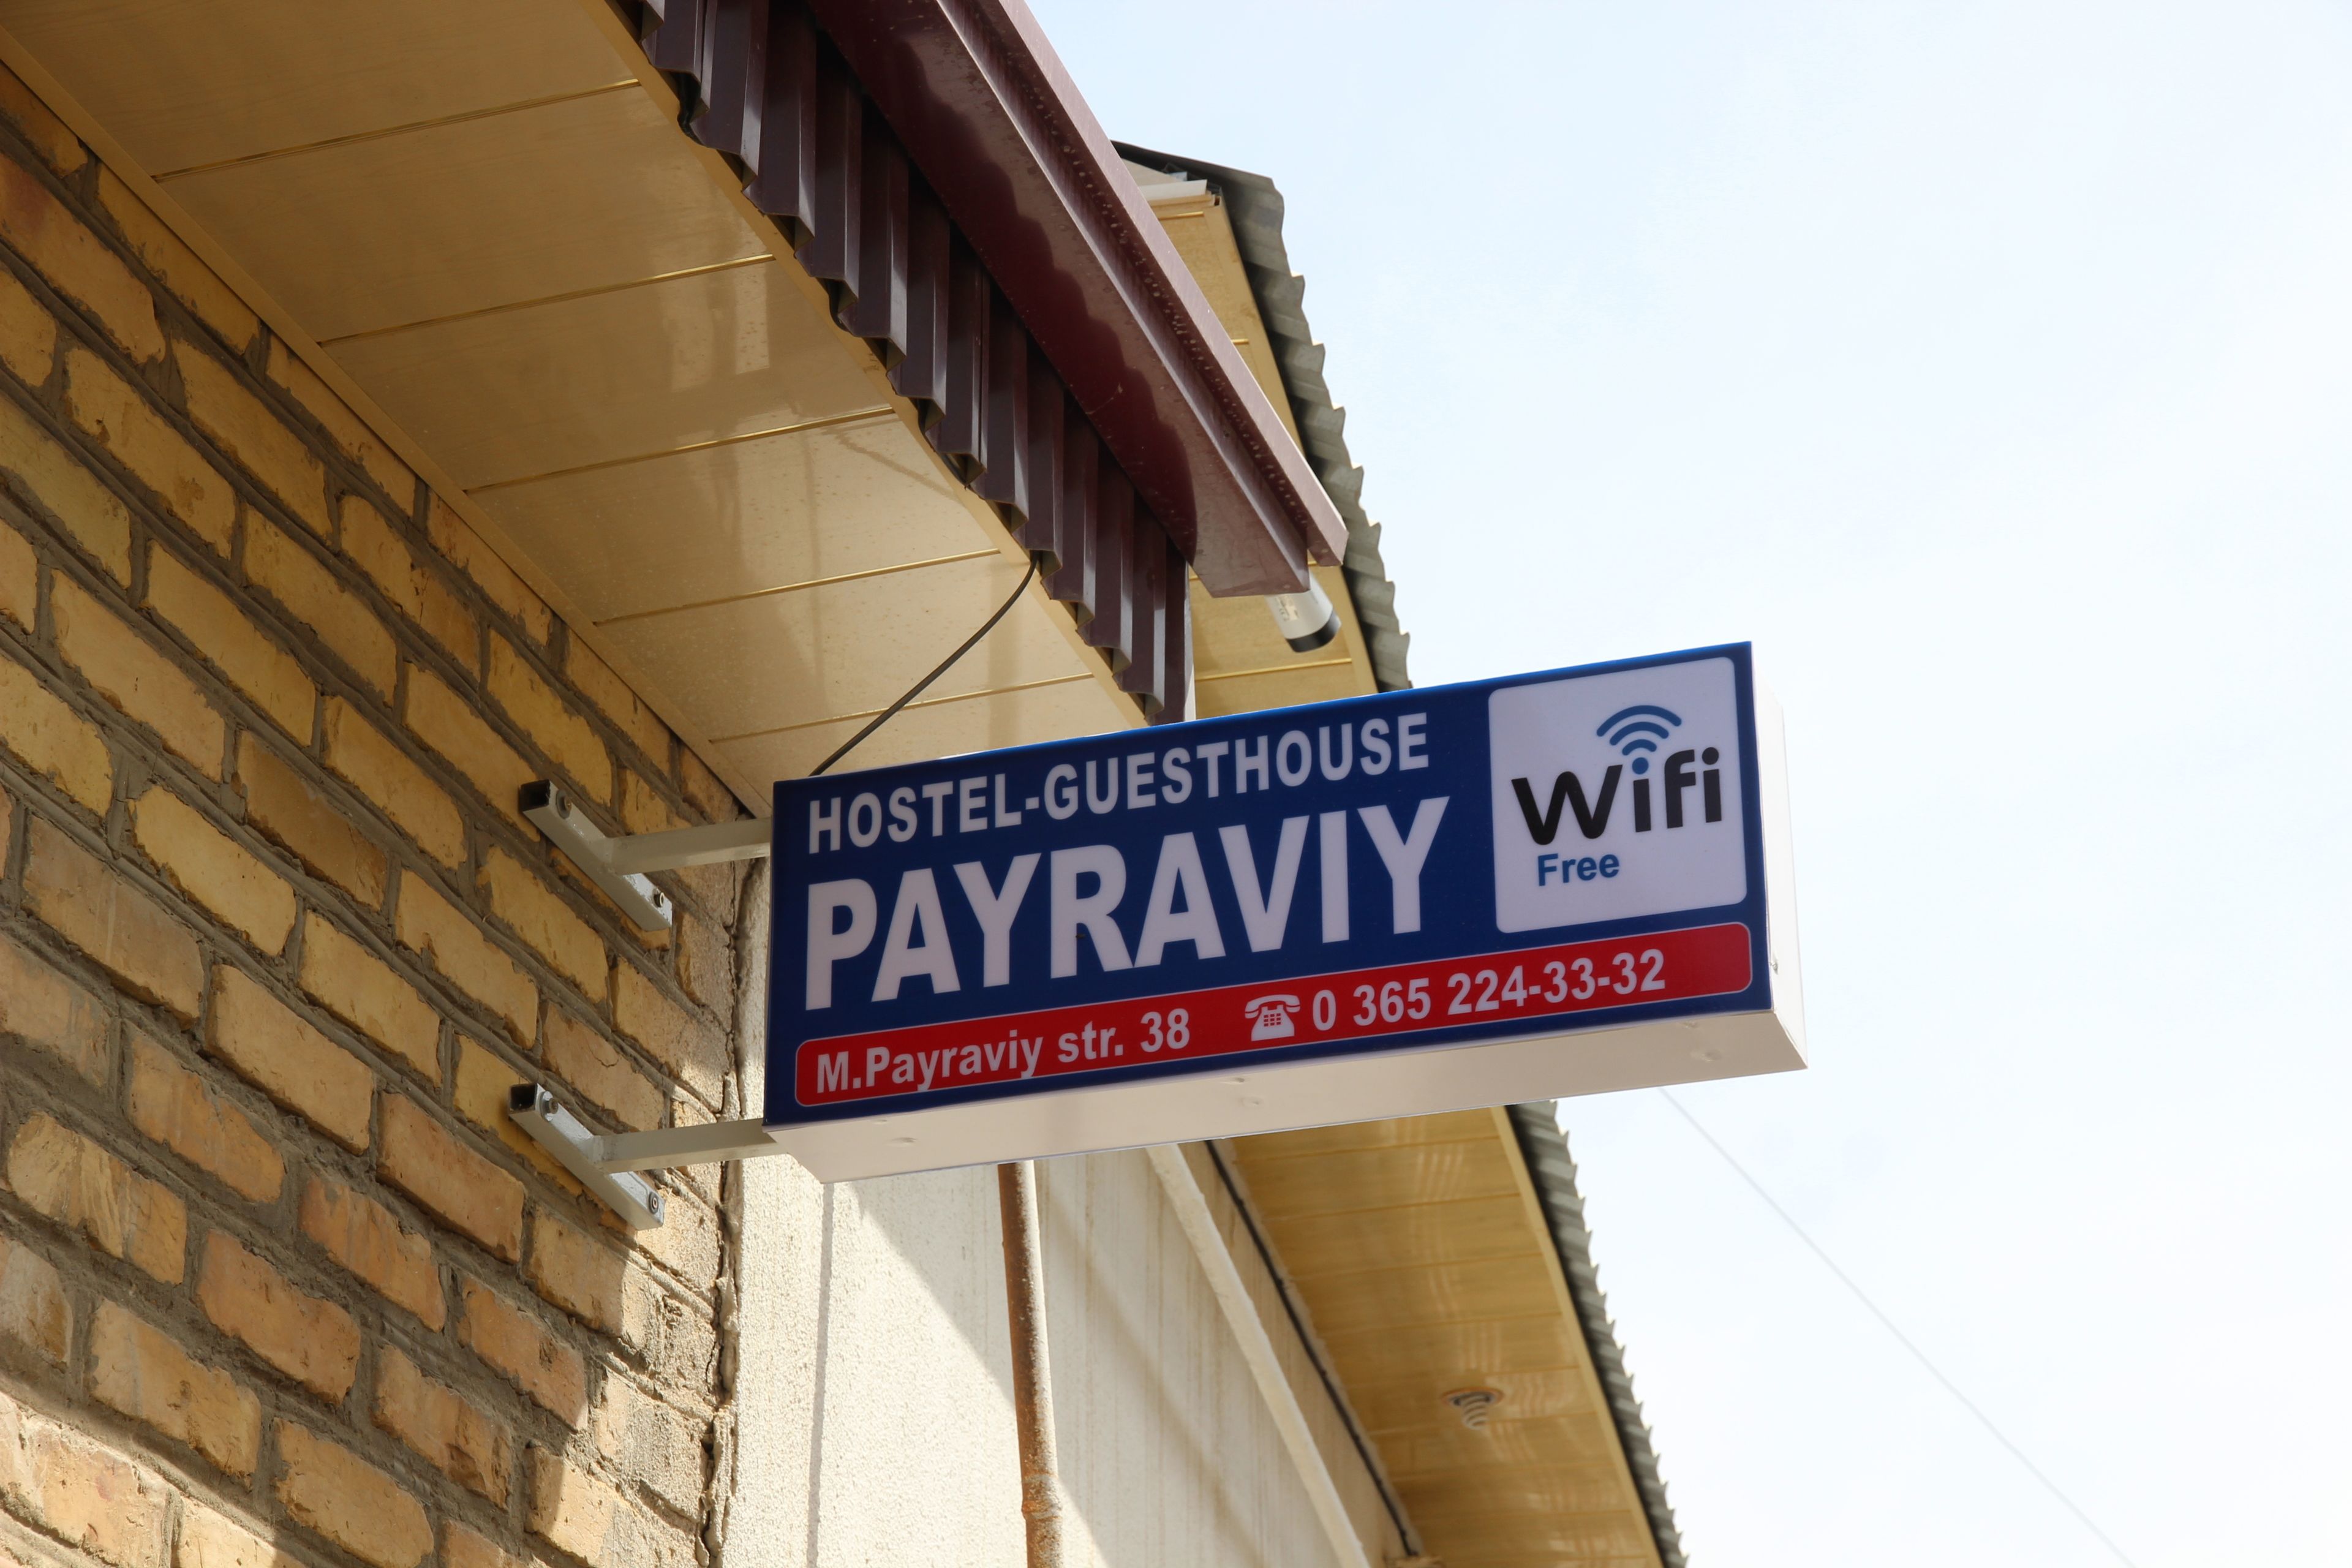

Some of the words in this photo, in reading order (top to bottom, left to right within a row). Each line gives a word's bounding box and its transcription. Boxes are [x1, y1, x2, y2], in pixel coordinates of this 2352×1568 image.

[809, 712, 1430, 854] HOSTEL-GUESTHOUSE
[1511, 746, 1723, 846] Wifi
[805, 796, 1450, 1011] PAYRAVIY
[1537, 853, 1621, 887] Free
[1312, 989, 1336, 1031] 0
[1354, 978, 1431, 1027] 365
[1447, 948, 1666, 1016] 224-33-32
[815, 1030, 1044, 1094] M.Payraviy
[1057, 1020, 1125, 1063] str.
[1140, 1008, 1190, 1053] 38
